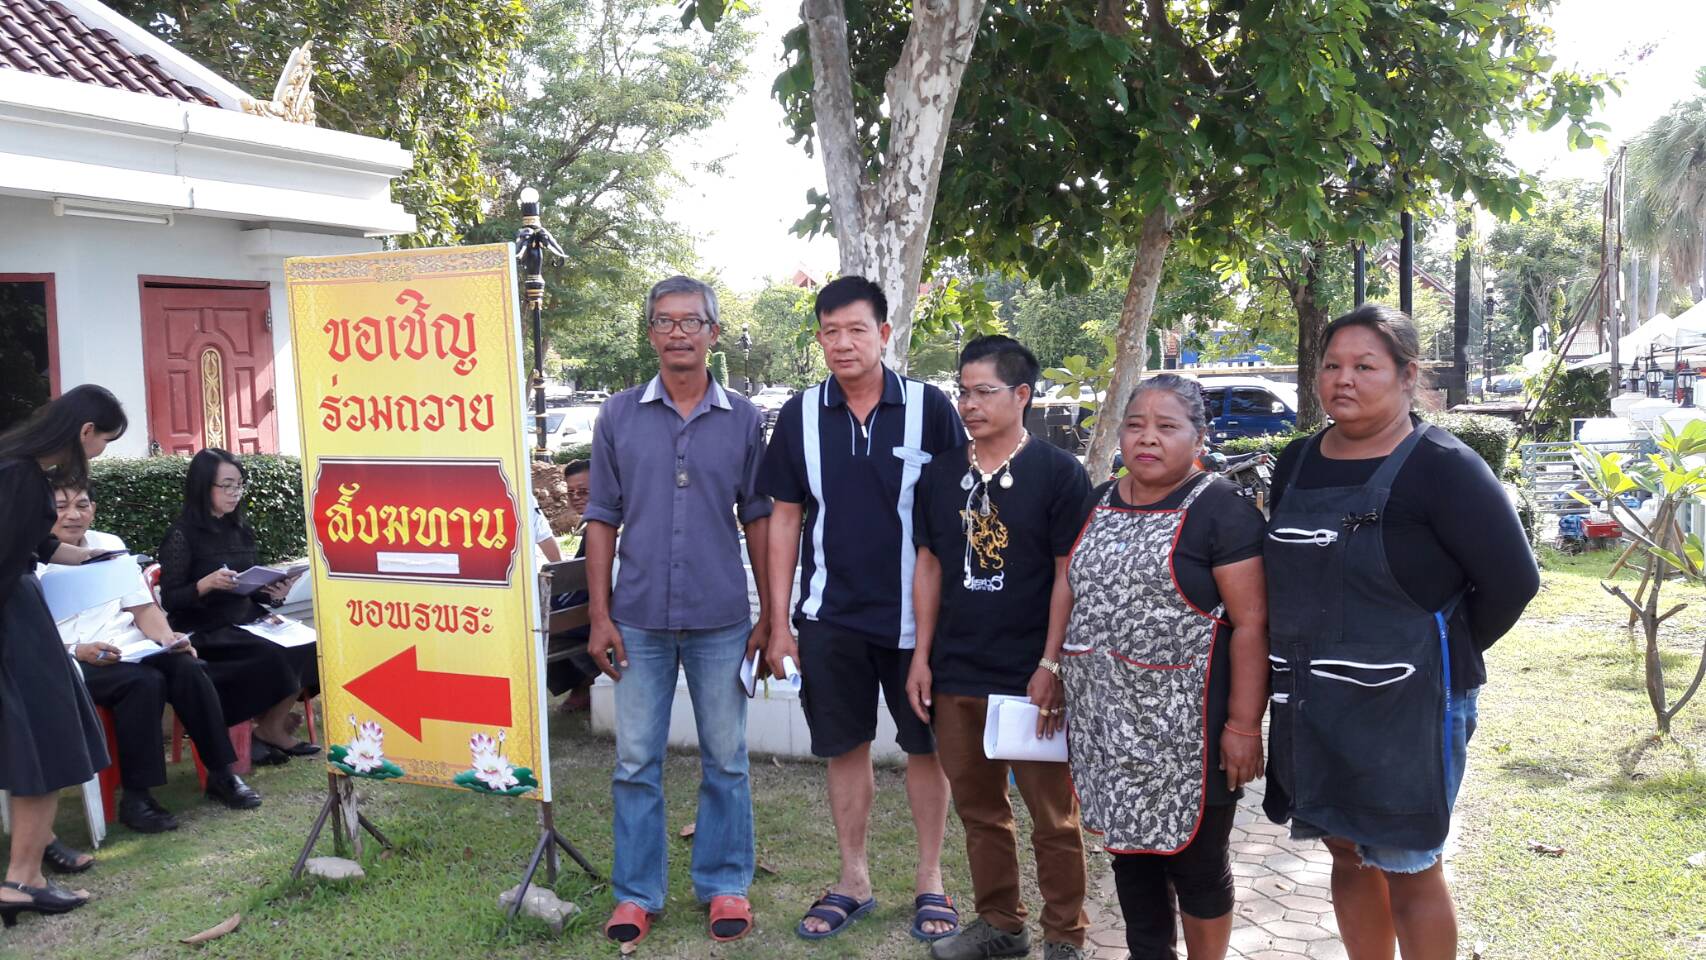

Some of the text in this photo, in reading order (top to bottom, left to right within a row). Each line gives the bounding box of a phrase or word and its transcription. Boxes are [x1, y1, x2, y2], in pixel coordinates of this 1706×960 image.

[323, 288, 478, 376] ขอเชิญ
[319, 374, 495, 432] ร่วมถวาย
[346, 599, 494, 635] ขอพรพระ
